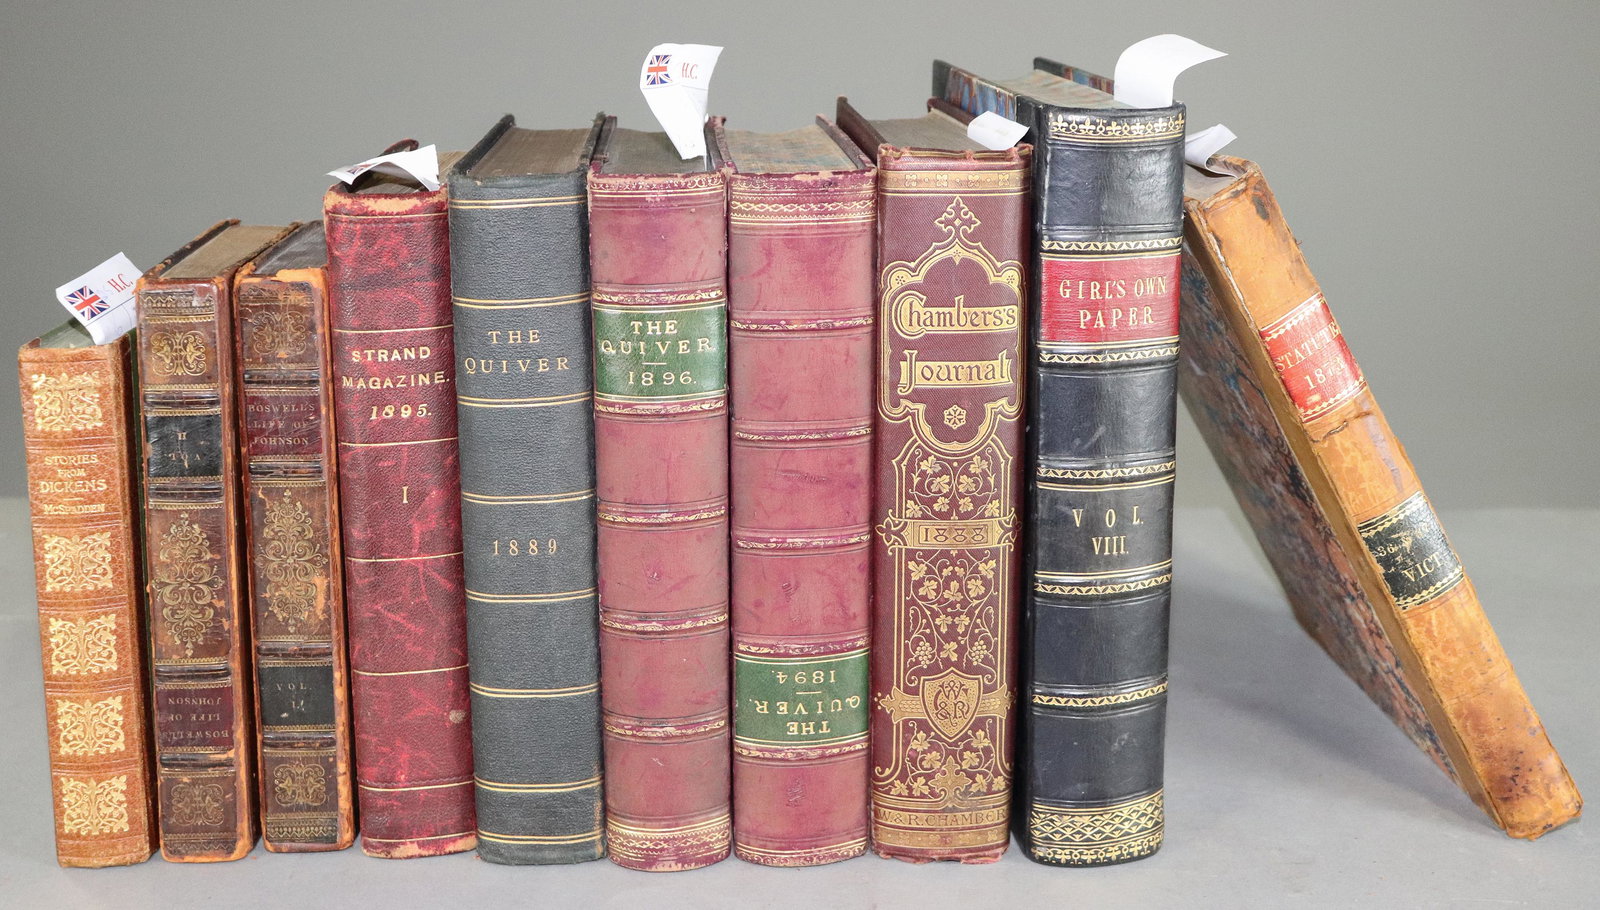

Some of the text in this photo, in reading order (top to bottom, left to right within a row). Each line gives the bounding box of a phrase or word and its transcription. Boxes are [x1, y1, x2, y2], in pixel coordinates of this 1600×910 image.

[1059, 276, 1168, 300] GIRL'S OWN
[891, 289, 1016, 340] Chambers's
[1079, 305, 1155, 330] PAPER
[630, 320, 678, 335] THE
[488, 329, 541, 345] THE
[352, 346, 431, 363] STRAND
[464, 357, 570, 375] QUIVER
[897, 349, 1008, 395] Journal
[341, 371, 450, 389] MAGAZINE.
[628, 371, 697, 386] 1896.
[370, 403, 432, 420] 1895.
[253, 419, 285, 429] LIFE
[250, 436, 309, 446] JOHNSON
[44, 454, 99, 466] STORIES
[57, 468, 86, 478] FROM
[40, 479, 108, 493] DICKENS
[1072, 505, 1144, 528] VOL.
[924, 527, 985, 543] 1888
[492, 538, 557, 556] 1889
[1092, 535, 1129, 555] VIII.
[1401, 551, 1442, 582] VICT
[771, 669, 836, 684] 1894.
[168, 697, 221, 705] JOHNSON
[748, 695, 861, 715] QUIVER.
[190, 713, 220, 721] LIFE
[786, 720, 831, 735] THE
